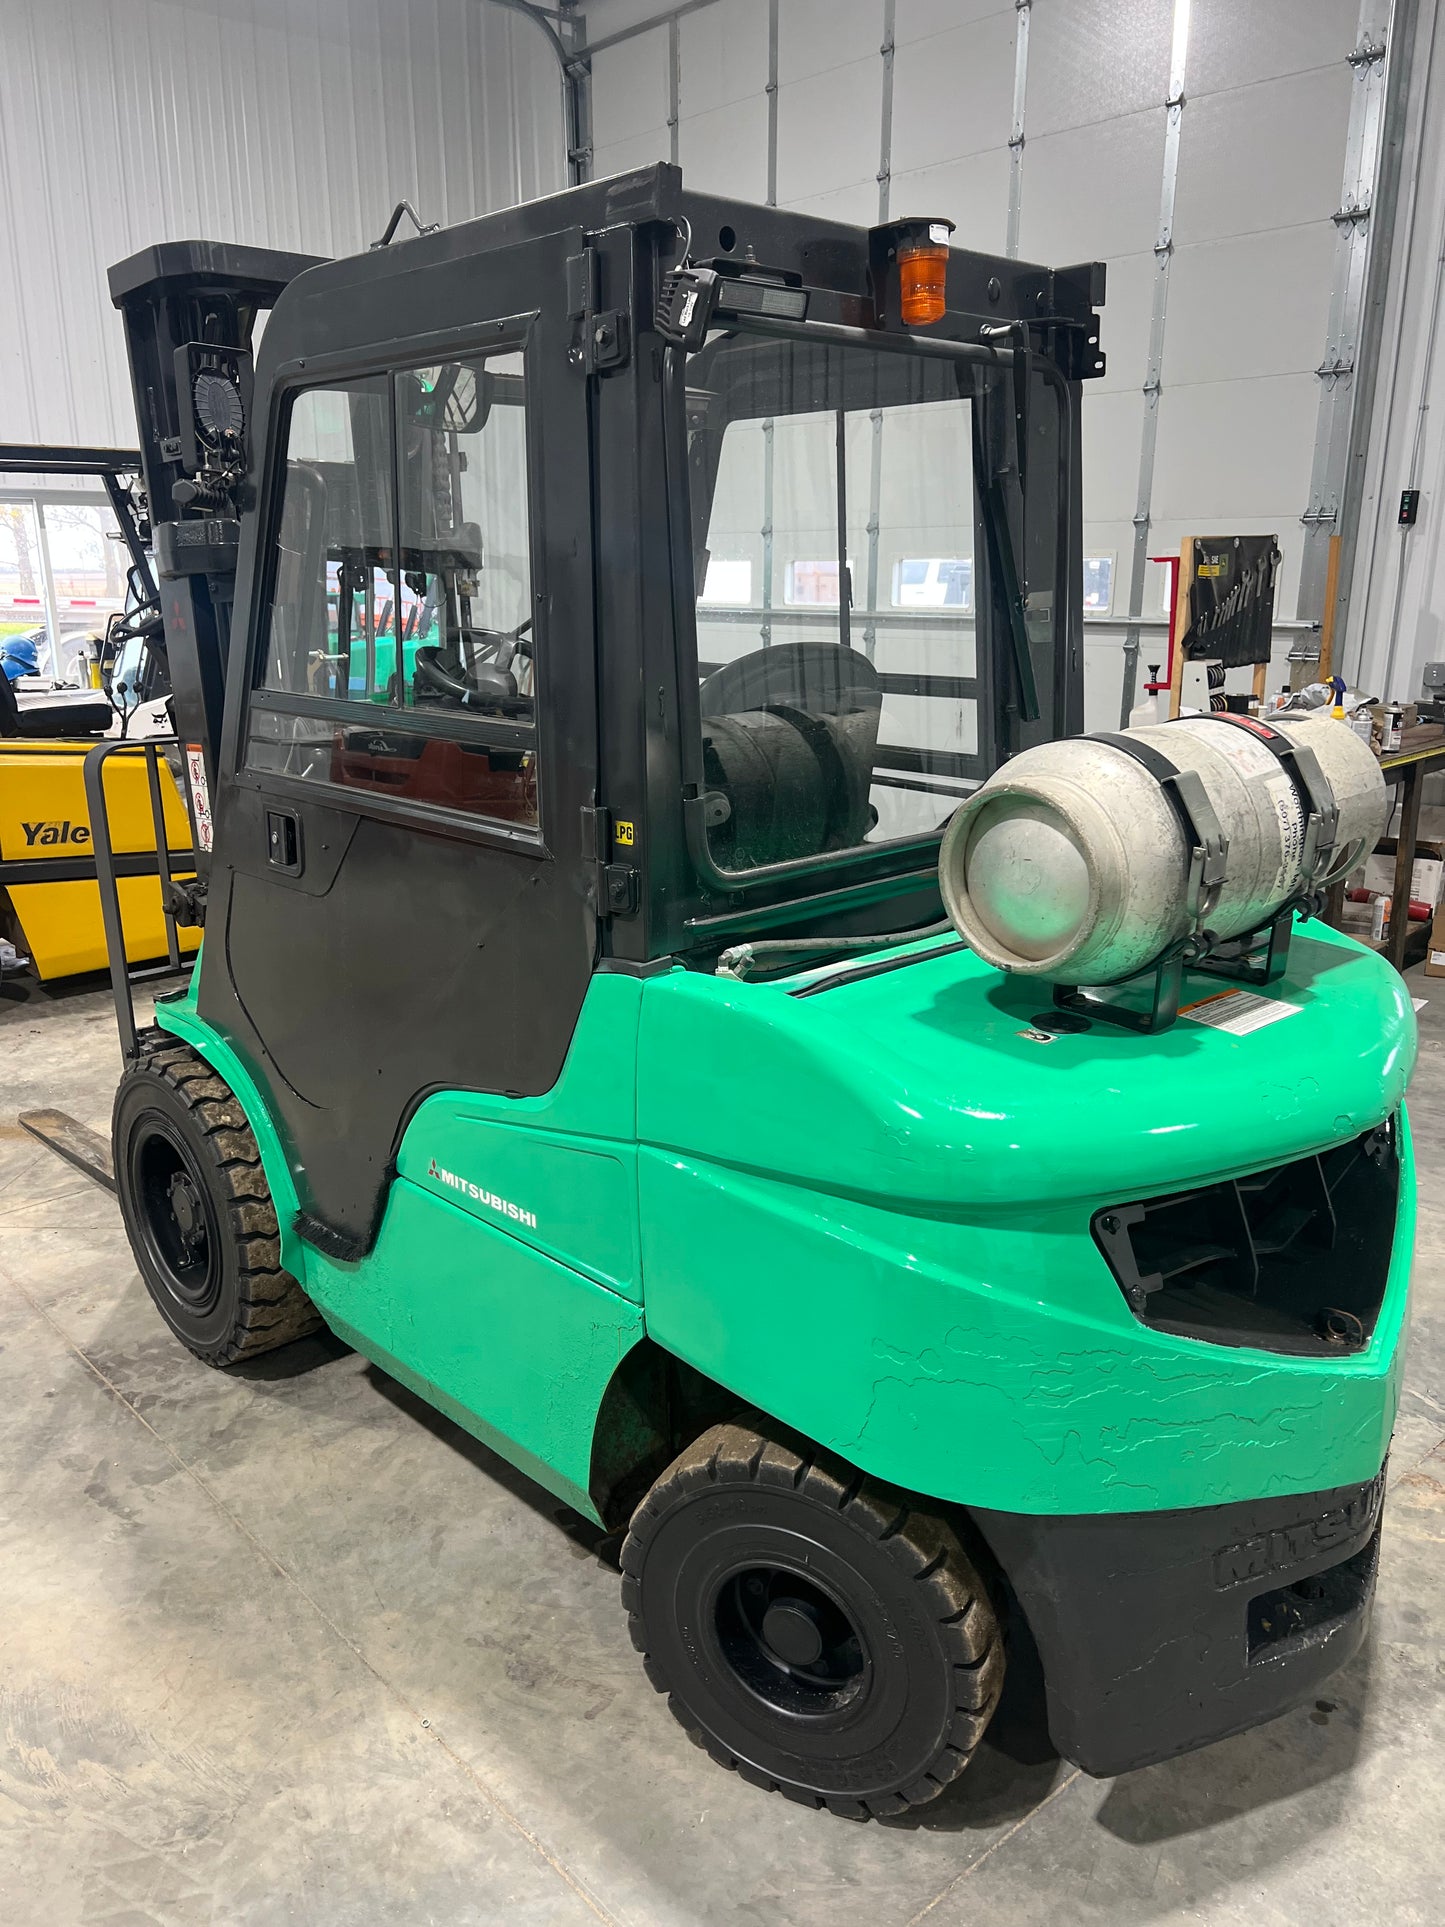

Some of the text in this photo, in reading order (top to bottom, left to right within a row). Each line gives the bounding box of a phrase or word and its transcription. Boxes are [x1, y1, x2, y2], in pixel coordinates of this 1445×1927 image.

[21, 820, 90, 846] Yale
[615, 825, 633, 840] LPG
[441, 1168, 537, 1229] MITSUBISHI
